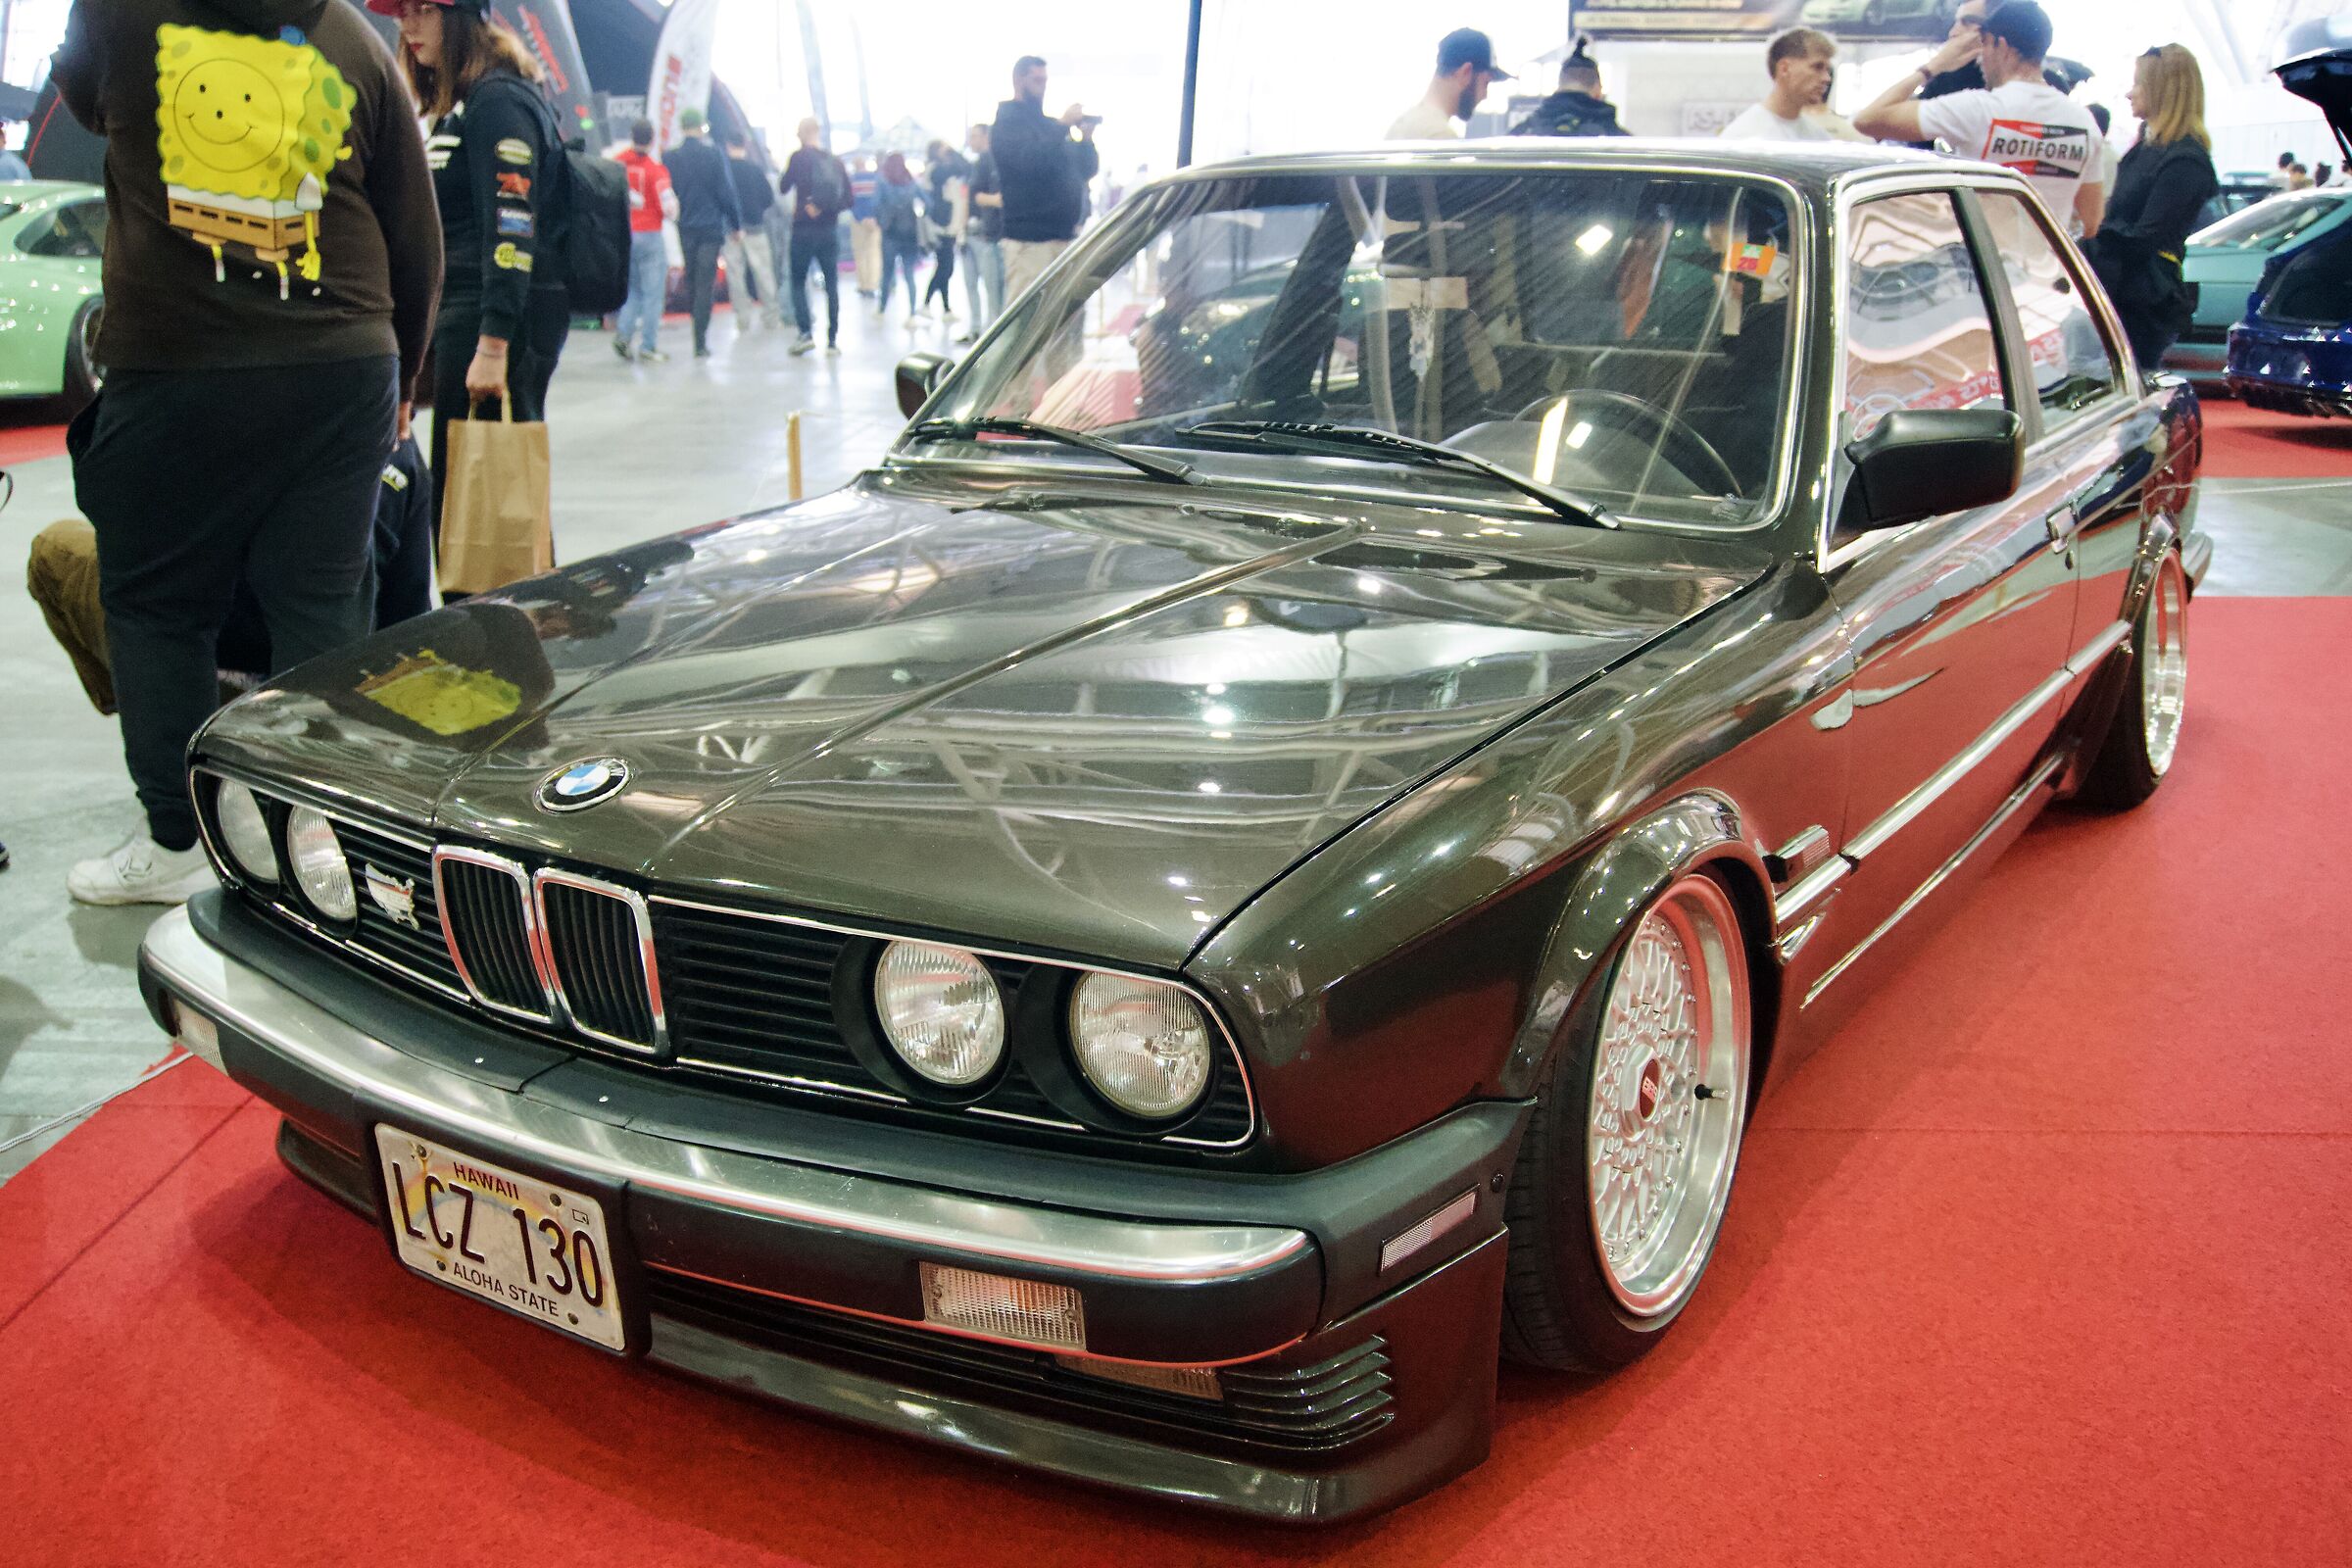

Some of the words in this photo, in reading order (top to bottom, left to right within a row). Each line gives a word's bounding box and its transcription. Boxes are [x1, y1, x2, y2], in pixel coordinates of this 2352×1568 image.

[1992, 137, 2083, 161] ROTIFORM
[454, 1161, 519, 1200] HAWAII
[392, 1161, 486, 1264] LCZ
[513, 1207, 604, 1308] 130
[453, 1261, 505, 1297] ALOHA
[509, 1284, 560, 1317] STATE
